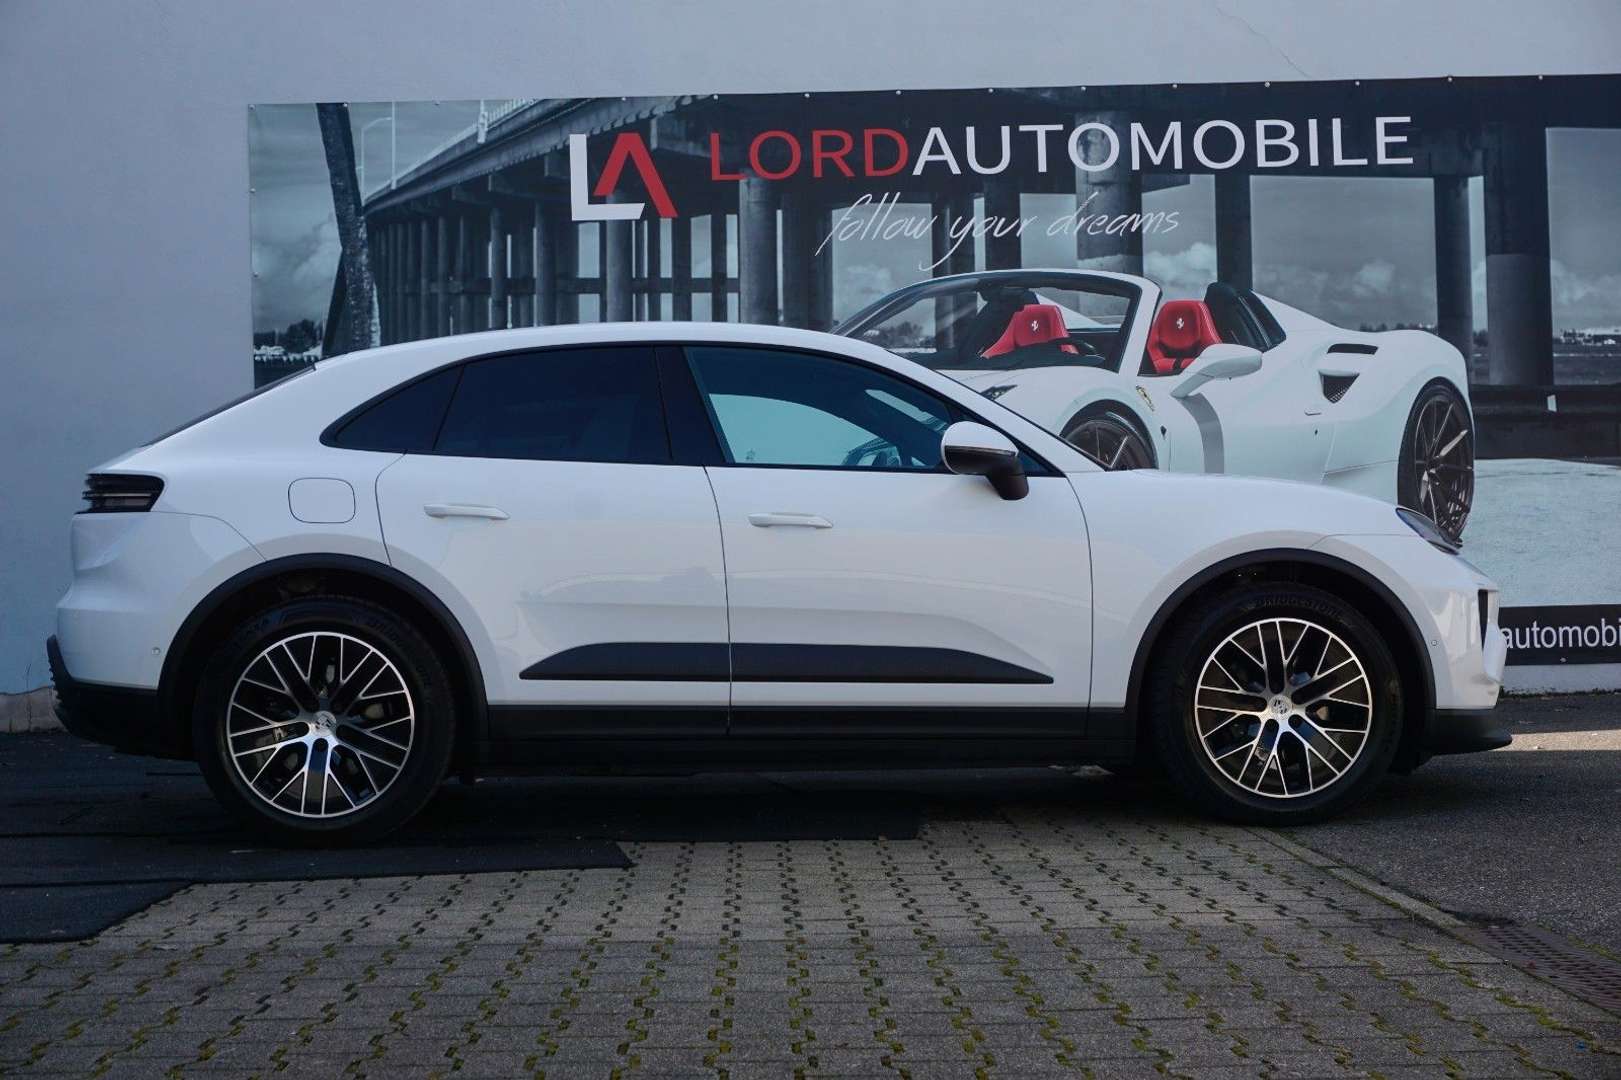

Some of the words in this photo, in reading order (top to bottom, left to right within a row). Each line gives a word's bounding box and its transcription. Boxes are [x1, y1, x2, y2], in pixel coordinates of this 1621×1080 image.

[815, 192, 938, 257] follow
[918, 212, 1038, 272] your
[1047, 191, 1180, 238] dreams
